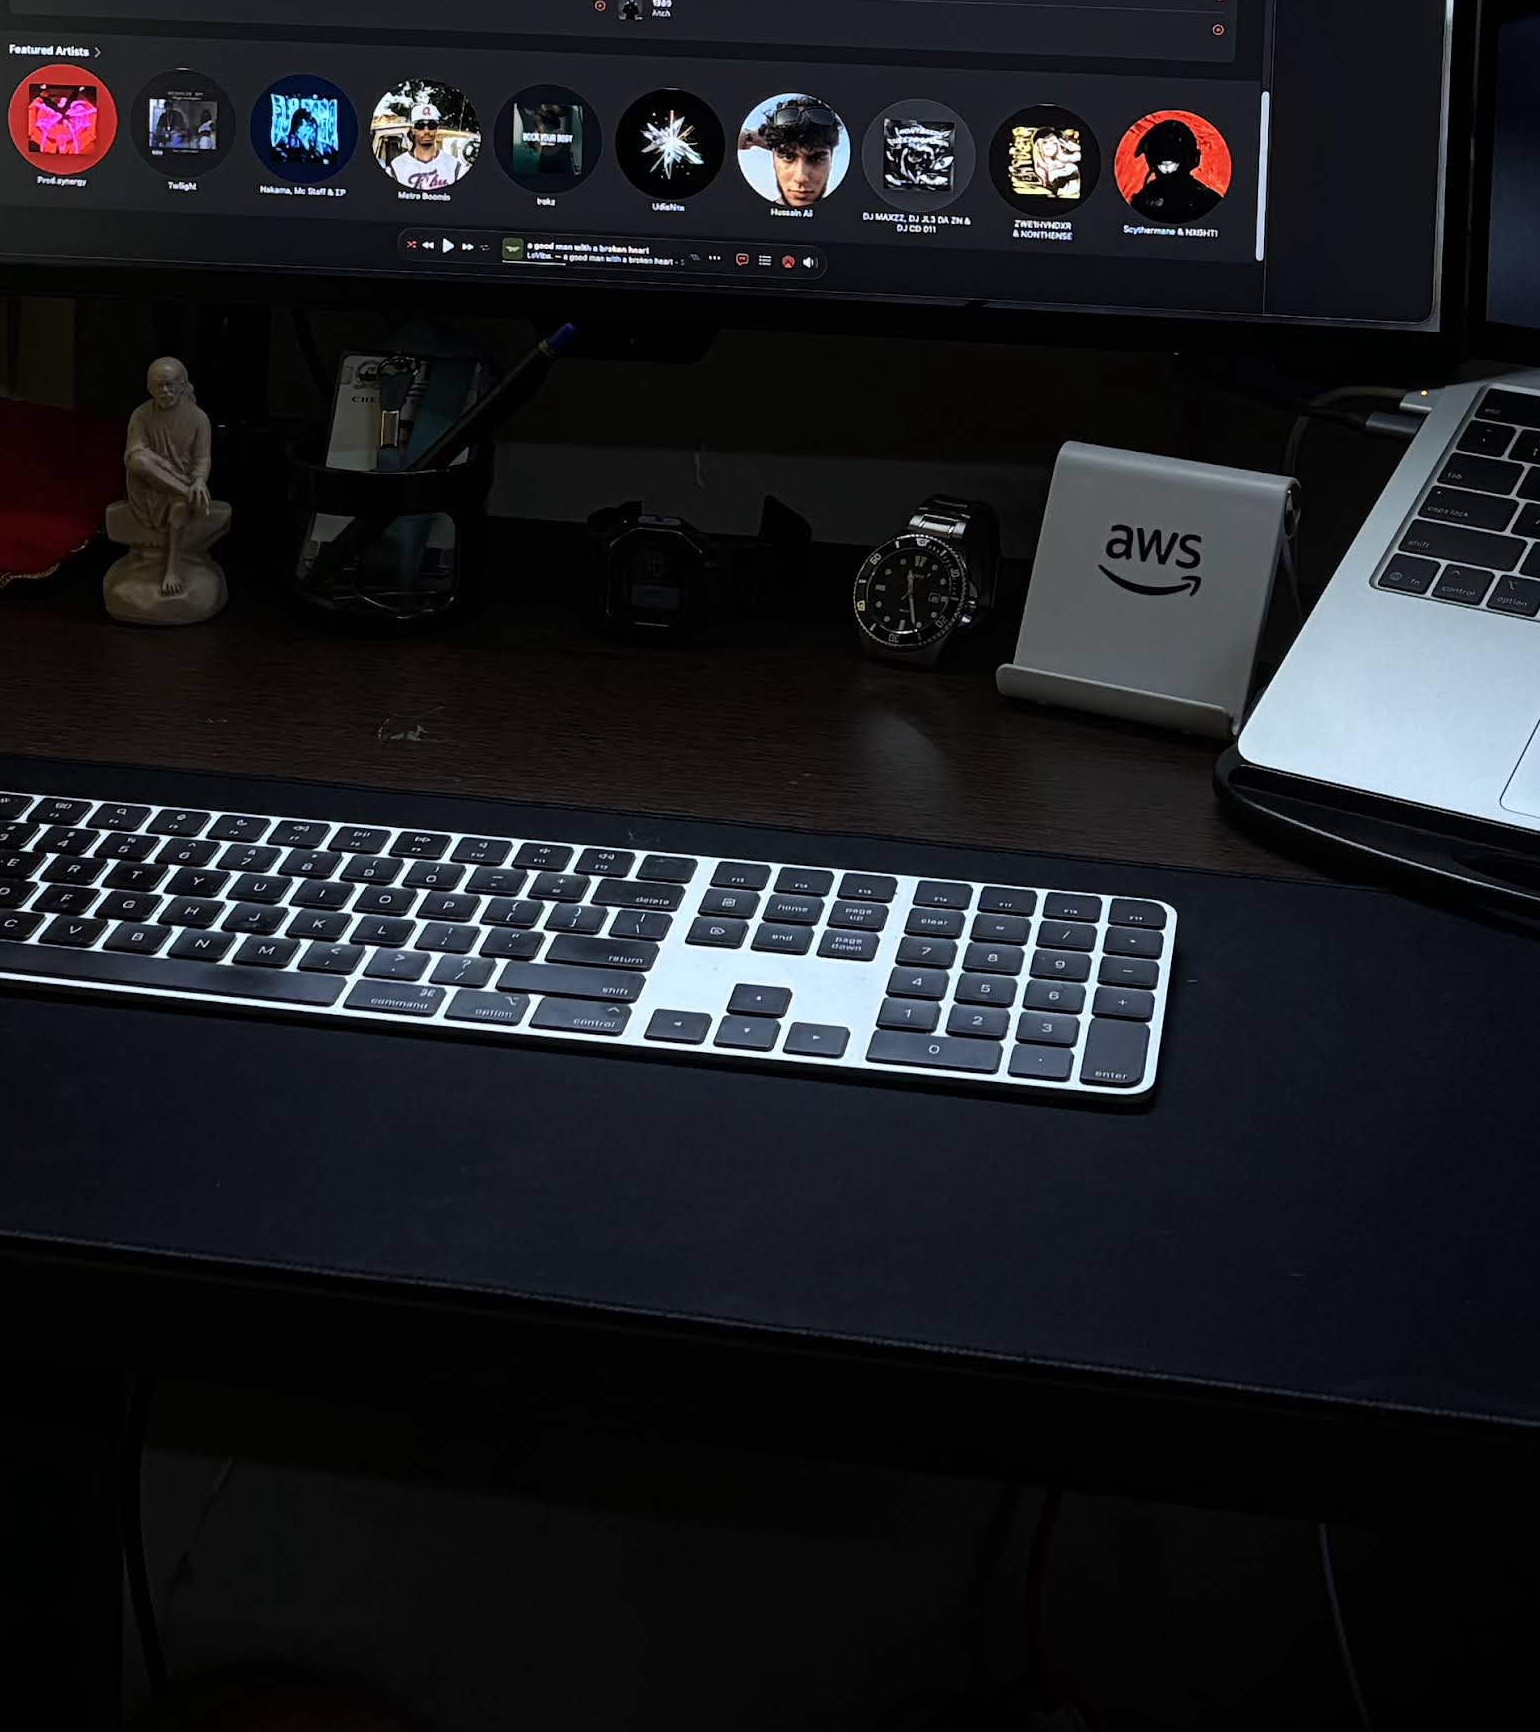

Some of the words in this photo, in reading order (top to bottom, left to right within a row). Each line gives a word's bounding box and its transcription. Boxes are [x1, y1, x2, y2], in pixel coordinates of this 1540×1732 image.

[9, 44, 53, 55] Featured
[55, 46, 89, 56] Artists
[168, 182, 196, 191] Twilight
[398, 191, 421, 199] Metro
[422, 192, 451, 201] Boomin
[534, 242, 554, 250] good
[599, 245, 627, 253] broken
[628, 246, 649, 254] heart
[1106, 524, 1202, 569] aws
[1442, 587, 1475, 597] control
[1496, 597, 1527, 608] option
[922, 947, 931, 955] 7
[606, 956, 643, 966] return
[988, 954, 998, 962] 8
[602, 988, 628, 996] shift
[1049, 991, 1059, 1000] 6
[905, 1009, 911, 1017] 1
[973, 1016, 983, 1025] 2
[1042, 1023, 1052, 1032] 3
[1095, 1071, 1127, 1080] enter
